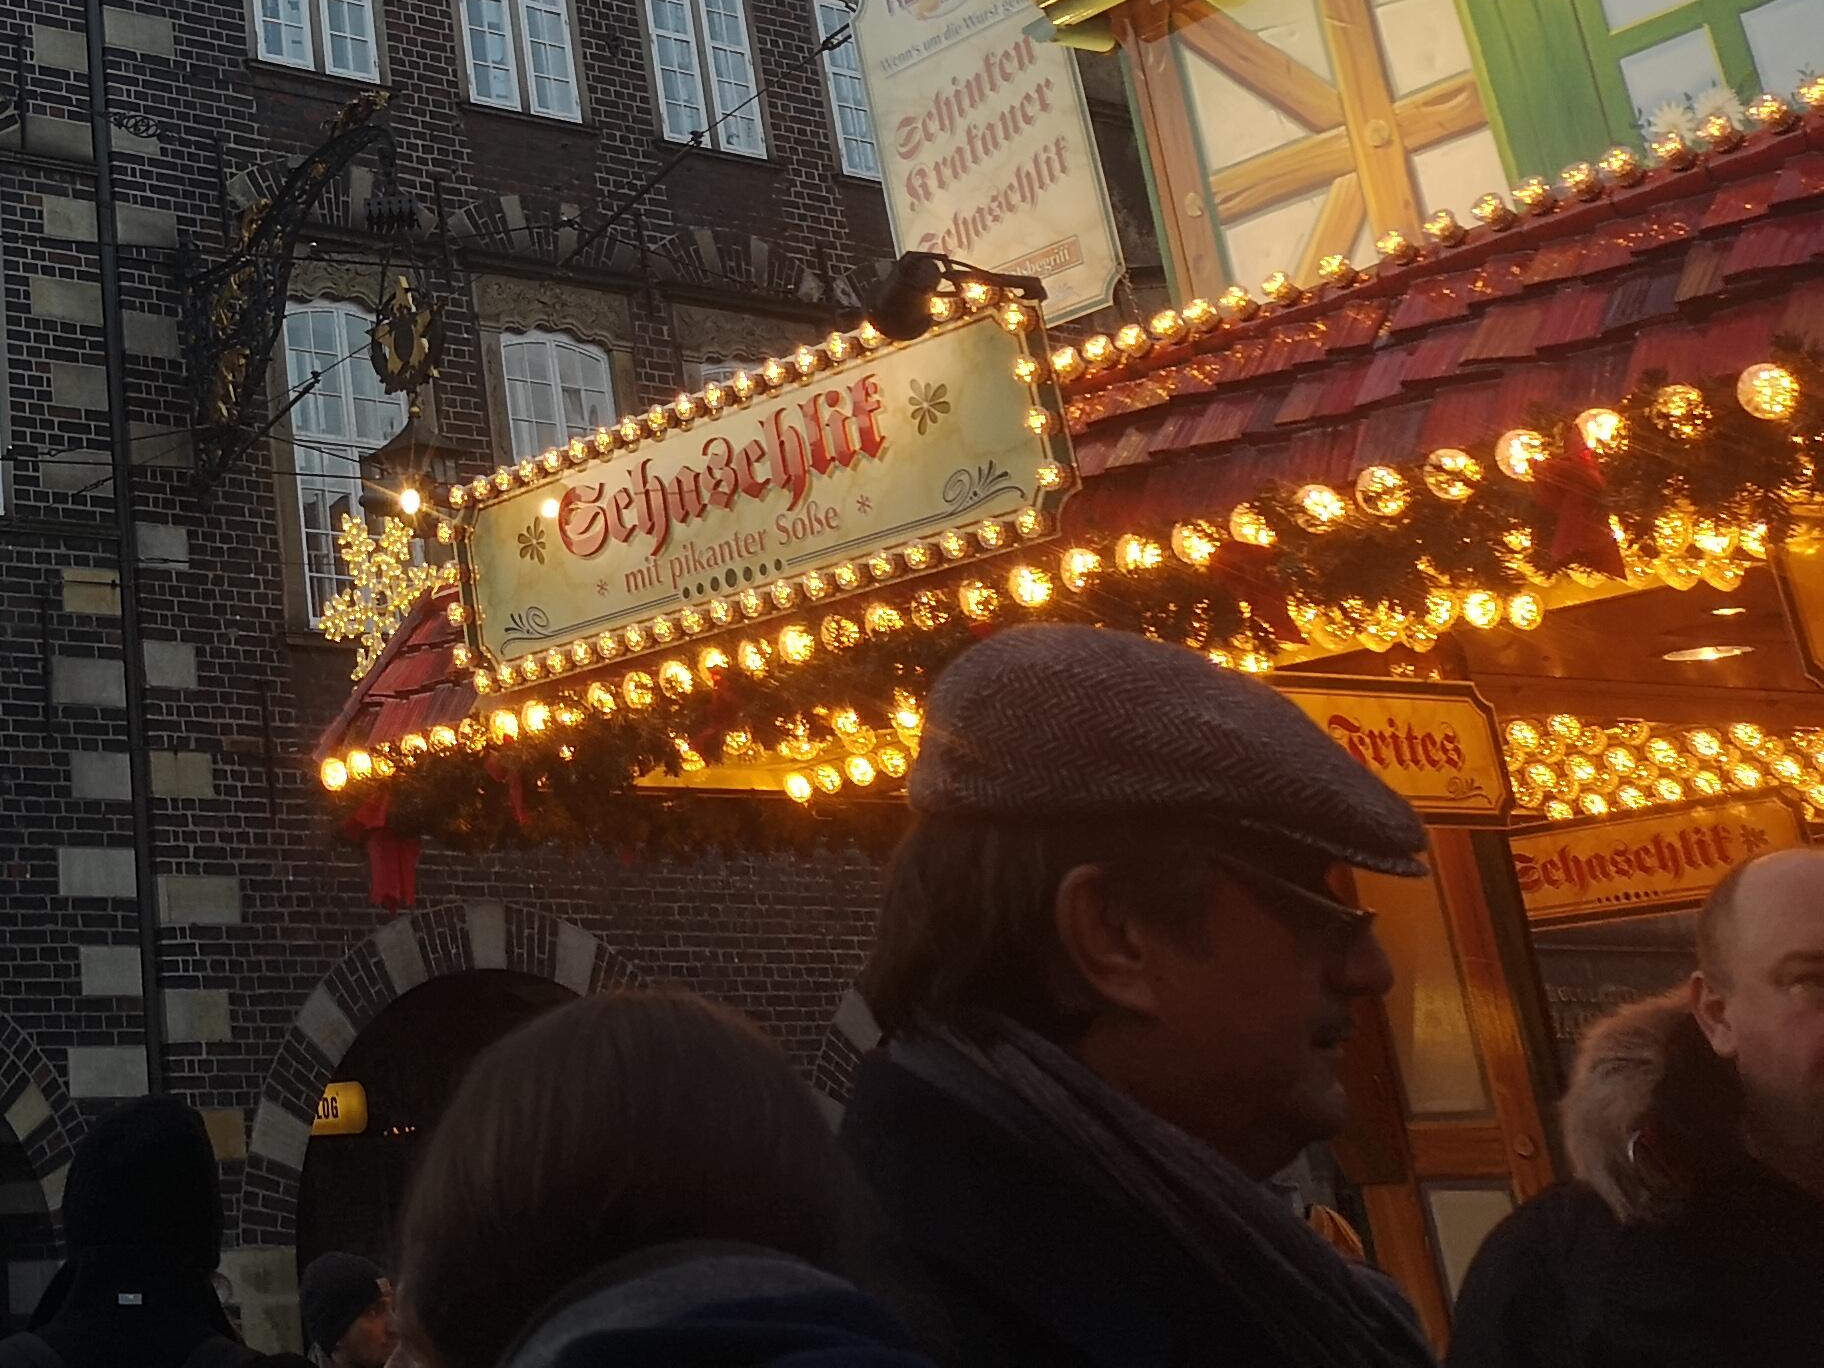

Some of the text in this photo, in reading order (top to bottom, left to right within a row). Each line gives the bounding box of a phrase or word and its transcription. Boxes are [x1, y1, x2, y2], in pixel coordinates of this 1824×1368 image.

[880, 44, 921, 72] Wenn's
[924, 34, 942, 51] um
[944, 23, 962, 42] die
[963, 3, 998, 30] Wurst
[895, 35, 1037, 160] Schinken
[906, 76, 1055, 213] Krakauer
[557, 372, 888, 557] Schaschlik
[624, 500, 841, 593] mit pikanter Soße
[1512, 824, 1732, 895] Schaschlik
